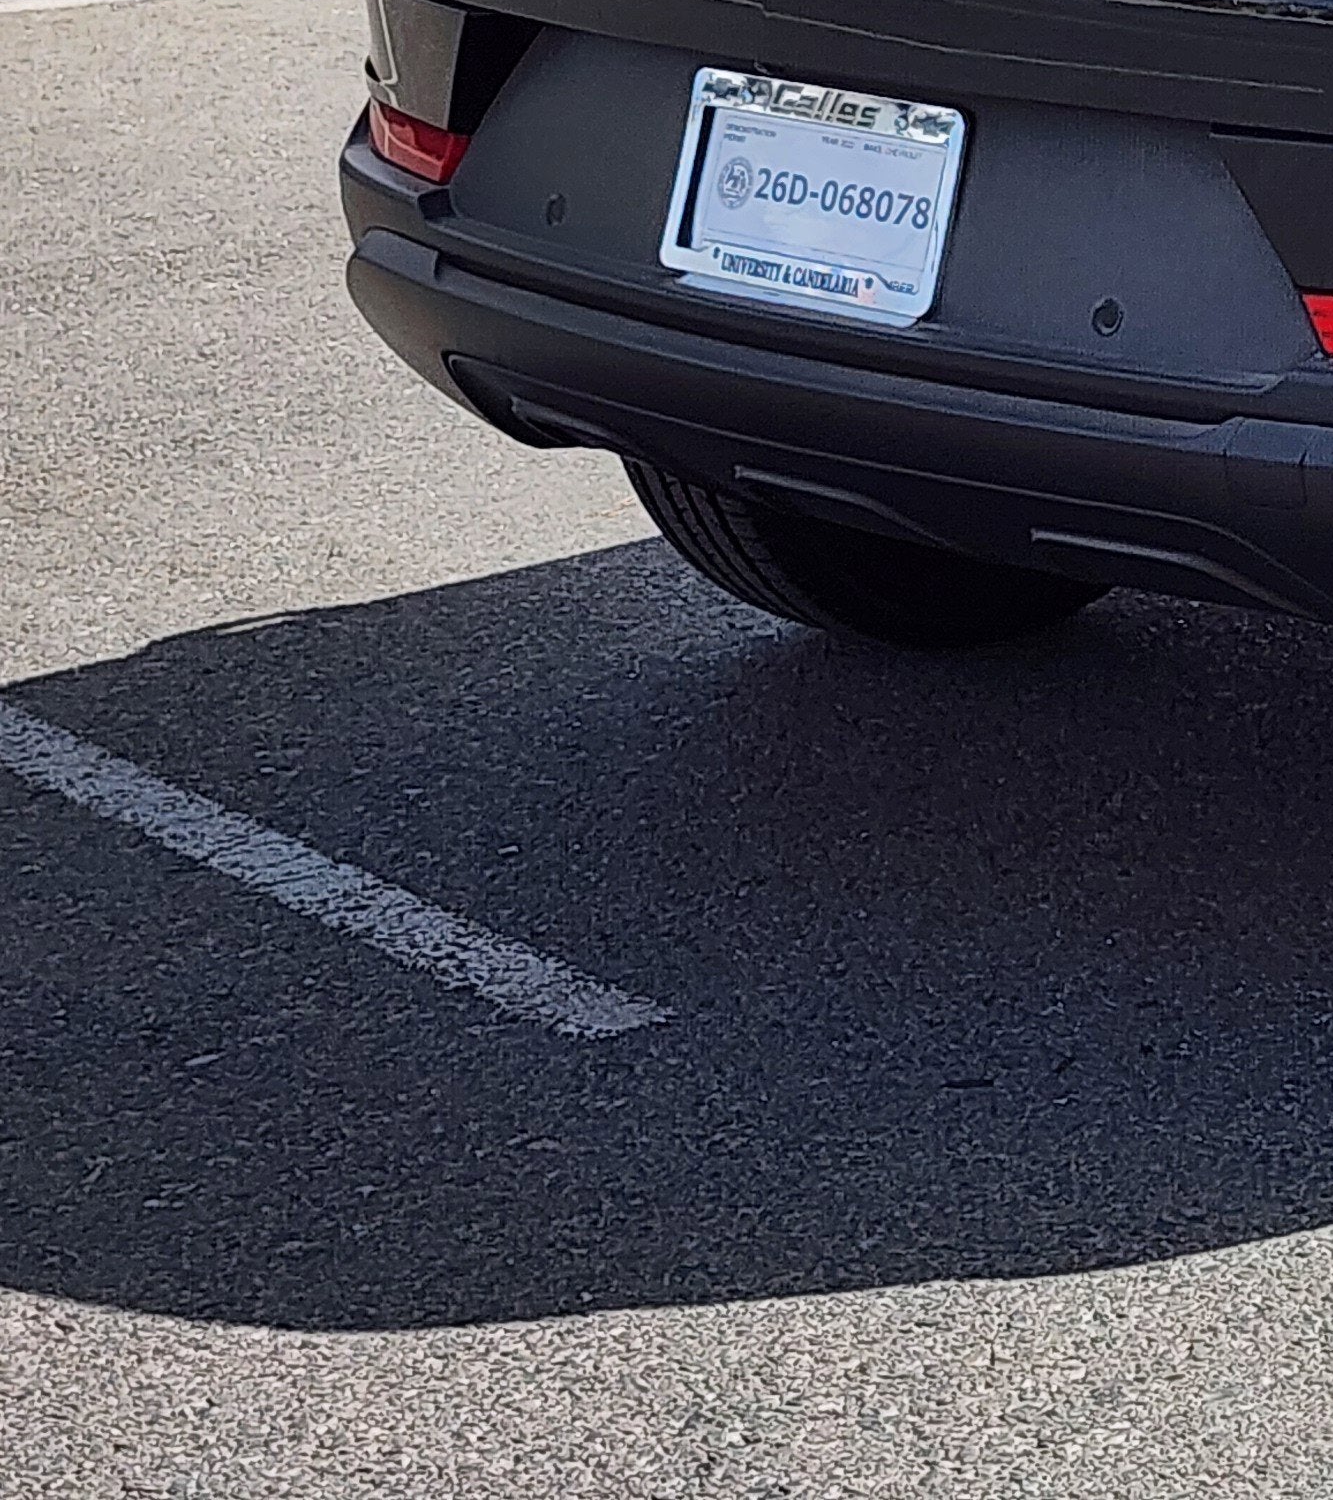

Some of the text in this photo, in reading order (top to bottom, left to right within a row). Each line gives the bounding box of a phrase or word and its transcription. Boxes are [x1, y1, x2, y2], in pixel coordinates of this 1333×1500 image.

[754, 167, 932, 230] 26D-068078
[721, 251, 783, 283] UNIVERSITY
[782, 264, 791, 284] &
[792, 266, 859, 298] CANDELARIA
